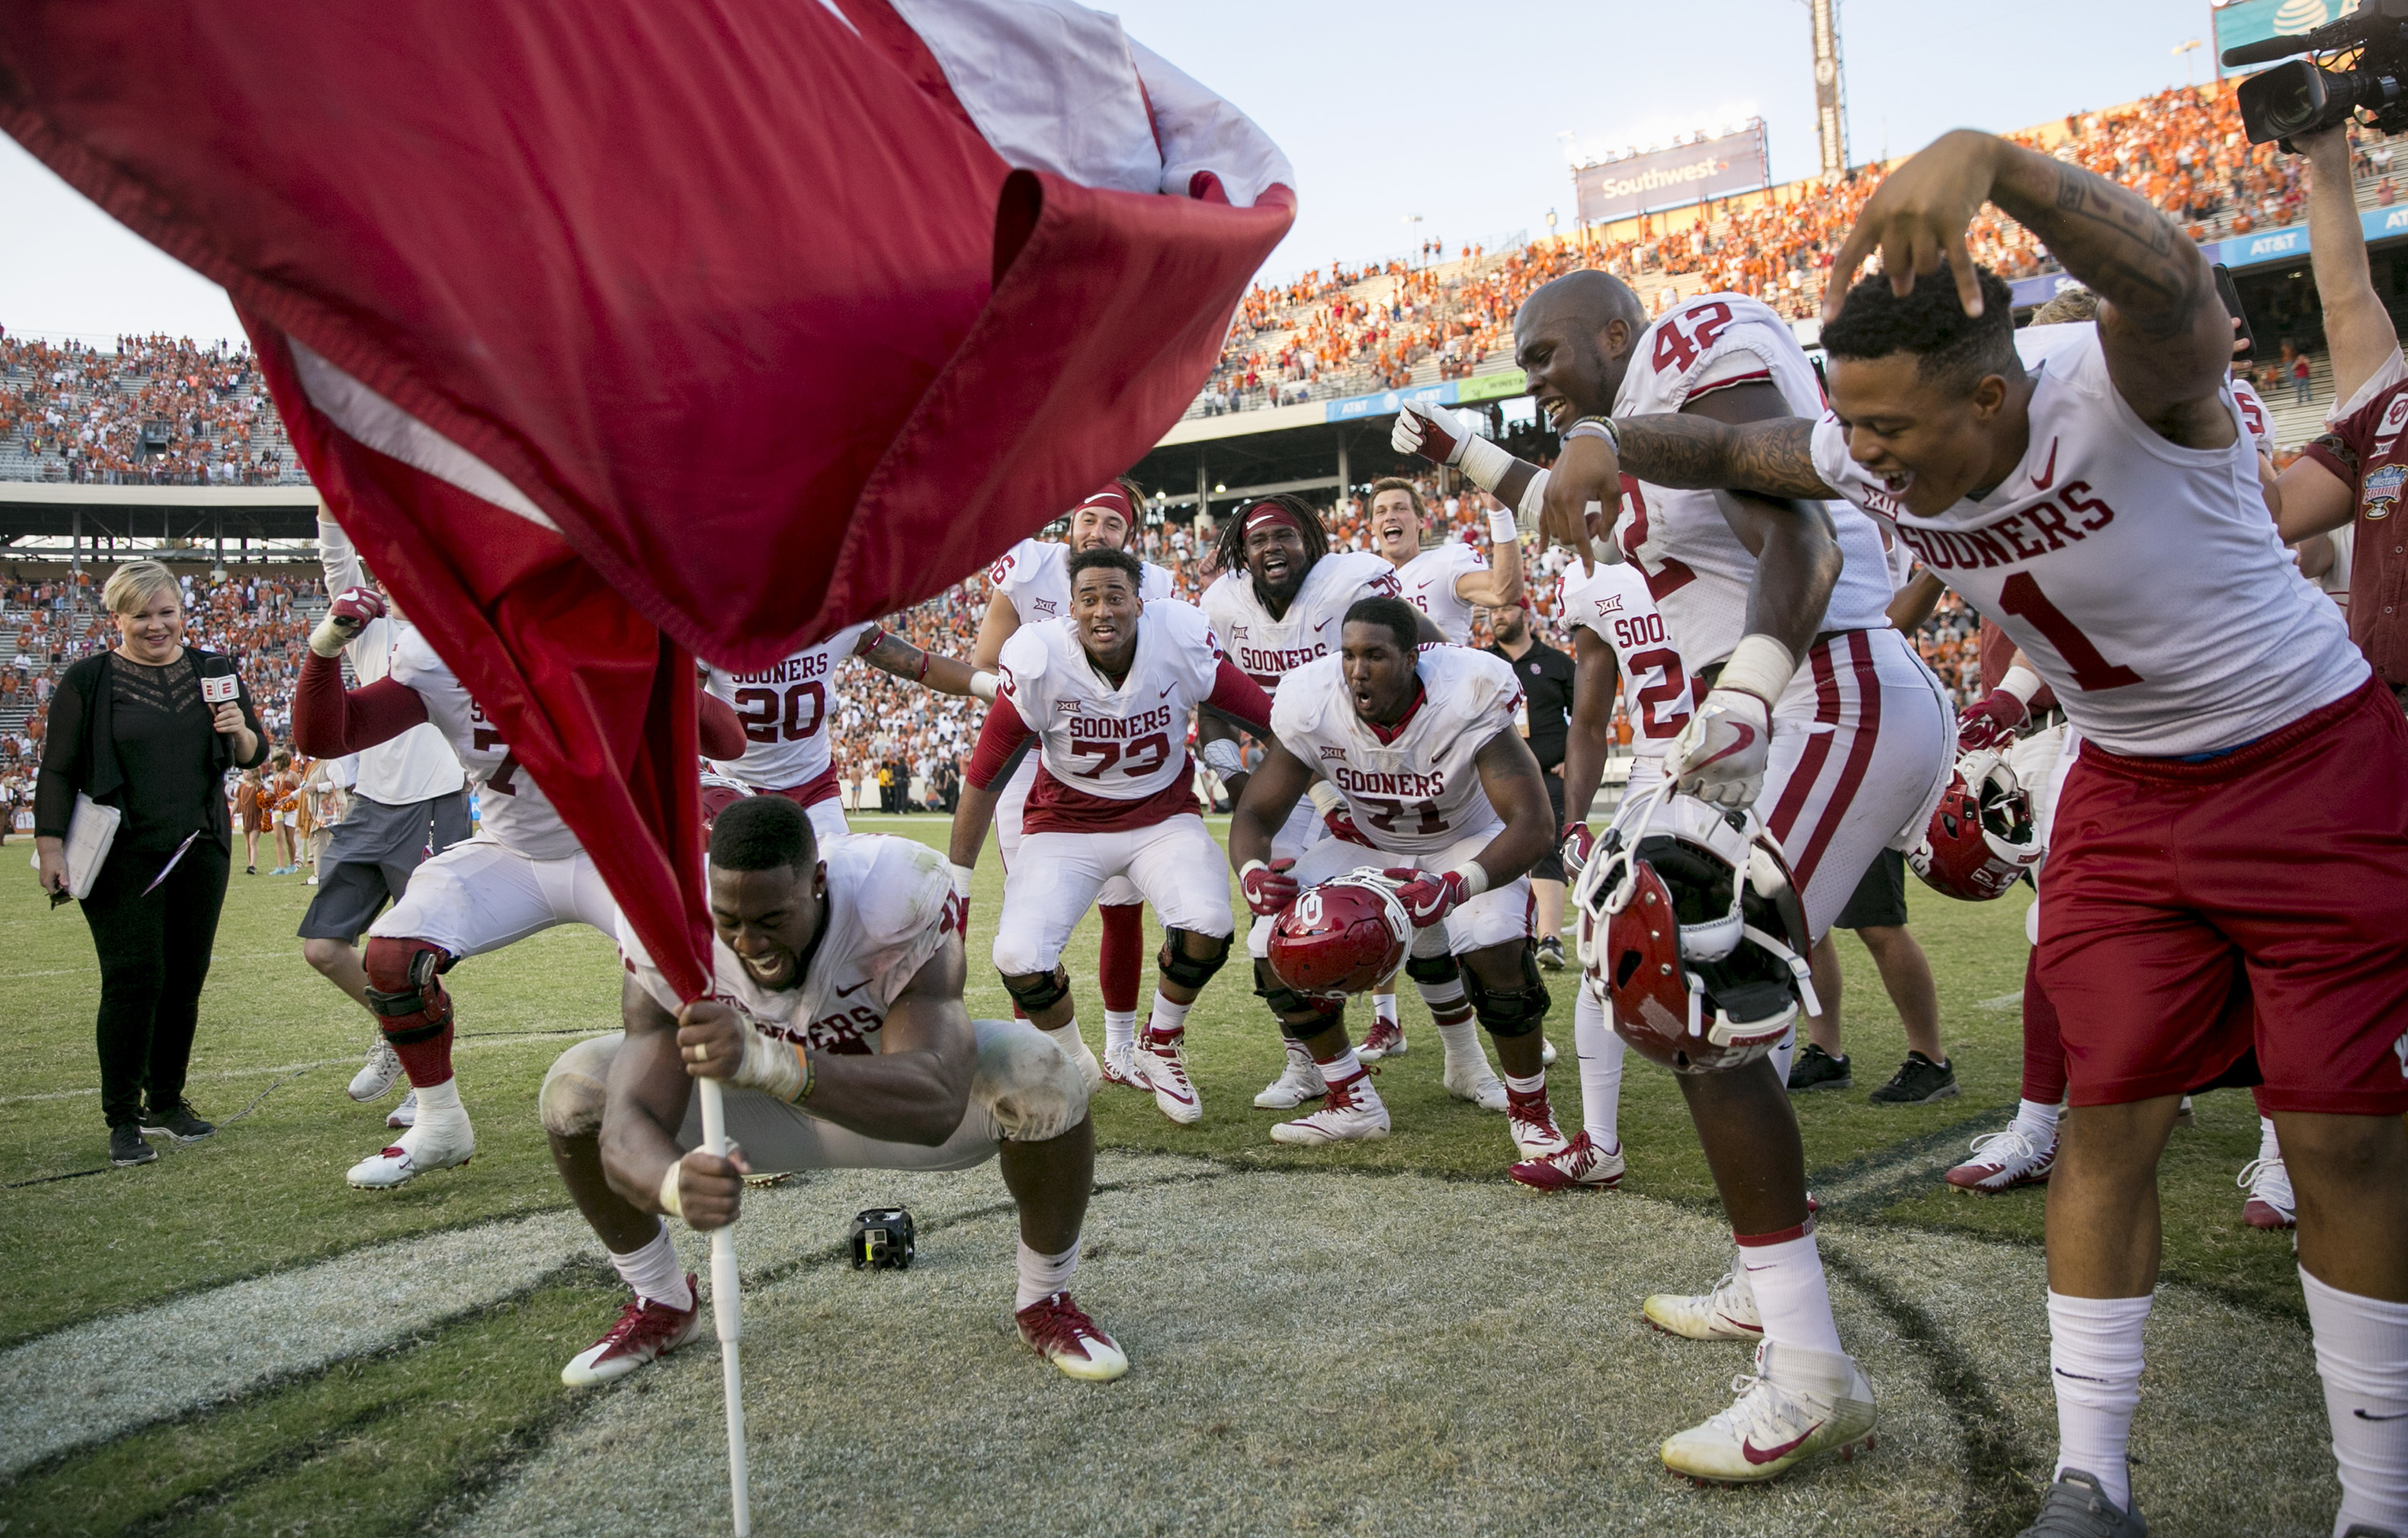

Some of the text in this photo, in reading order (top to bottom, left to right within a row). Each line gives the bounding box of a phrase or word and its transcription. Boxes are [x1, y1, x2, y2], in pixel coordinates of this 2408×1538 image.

[1604, 157, 1719, 199] Southwest
[2250, 232, 2297, 256] AT&T
[1652, 302, 1733, 375] 42
[1340, 400, 1369, 415] AT&T
[1414, 388, 1442, 402] AT&T
[2369, 475, 2401, 487] Allstate
[1613, 472, 1697, 603] 2
[1894, 481, 2114, 570] SOONERS
[1368, 568, 1403, 599] 58
[1615, 613, 1671, 649] SOO
[1999, 571, 2144, 691] 1
[1240, 642, 1328, 673] SOONERS
[734, 680, 825, 743] 20
[1057, 700, 1080, 711] XII
[1070, 705, 1171, 738] SOONERS
[1071, 732, 1171, 780] 73
[1336, 767, 1446, 798] SOONERS
[1354, 795, 1450, 835] 71
[1568, 1147, 1598, 1180] NIKE
